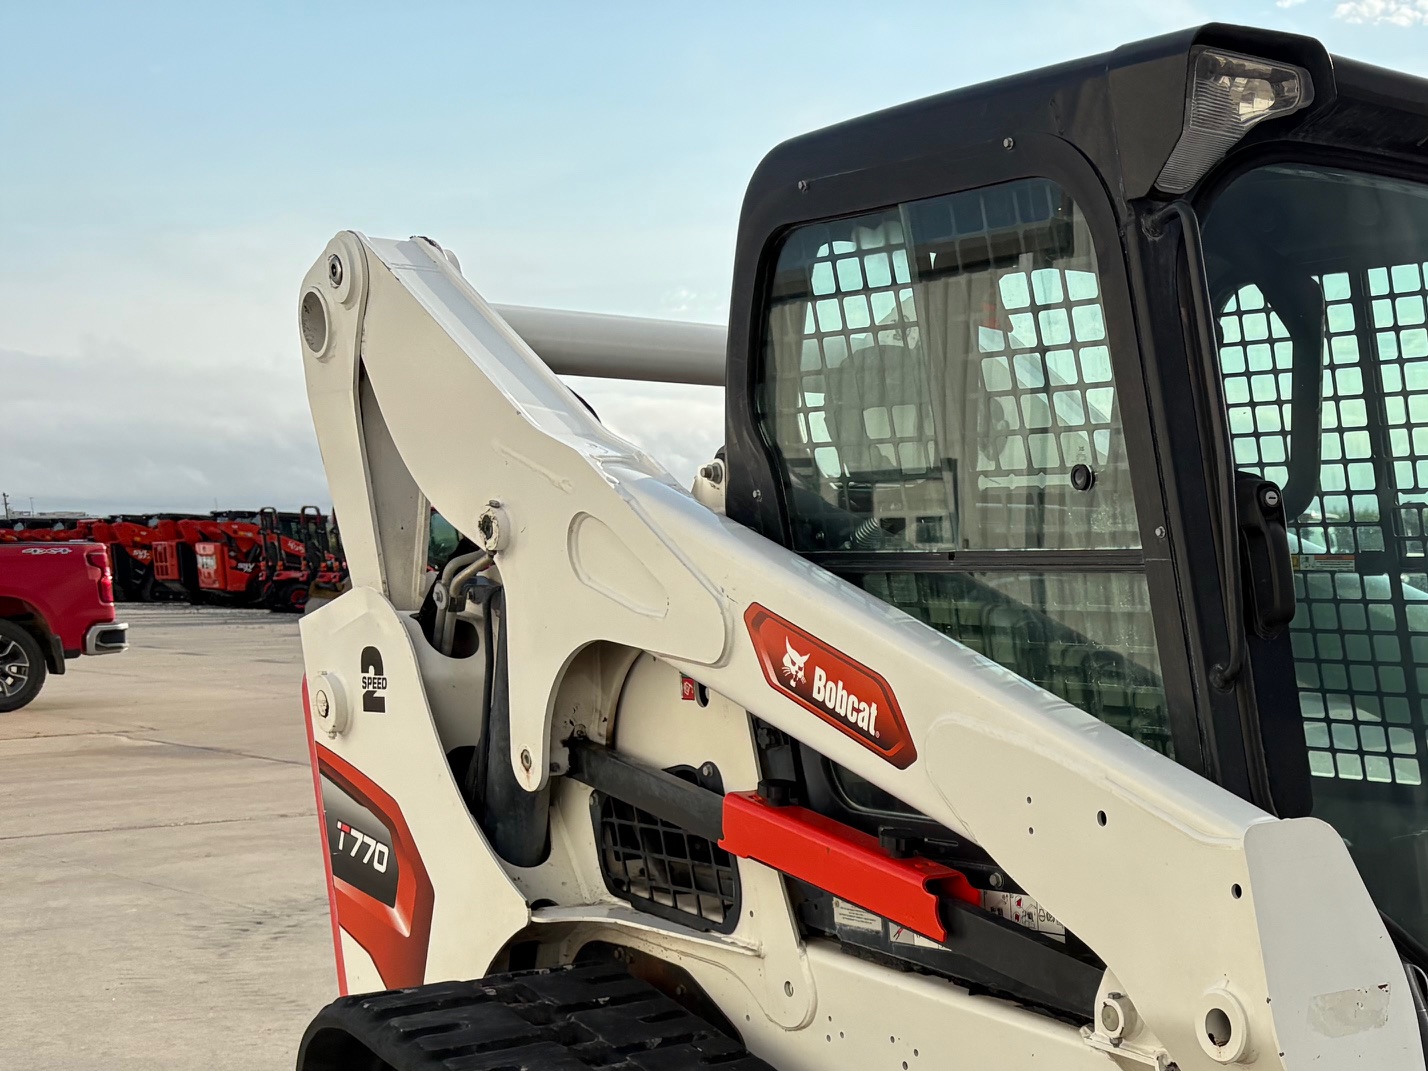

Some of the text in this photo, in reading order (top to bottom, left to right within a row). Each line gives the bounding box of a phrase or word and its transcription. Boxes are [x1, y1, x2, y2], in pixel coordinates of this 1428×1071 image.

[361, 645, 386, 714] 2
[361, 676, 388, 690] SPEED
[812, 665, 878, 737] Bobcat
[336, 820, 390, 874] T770
